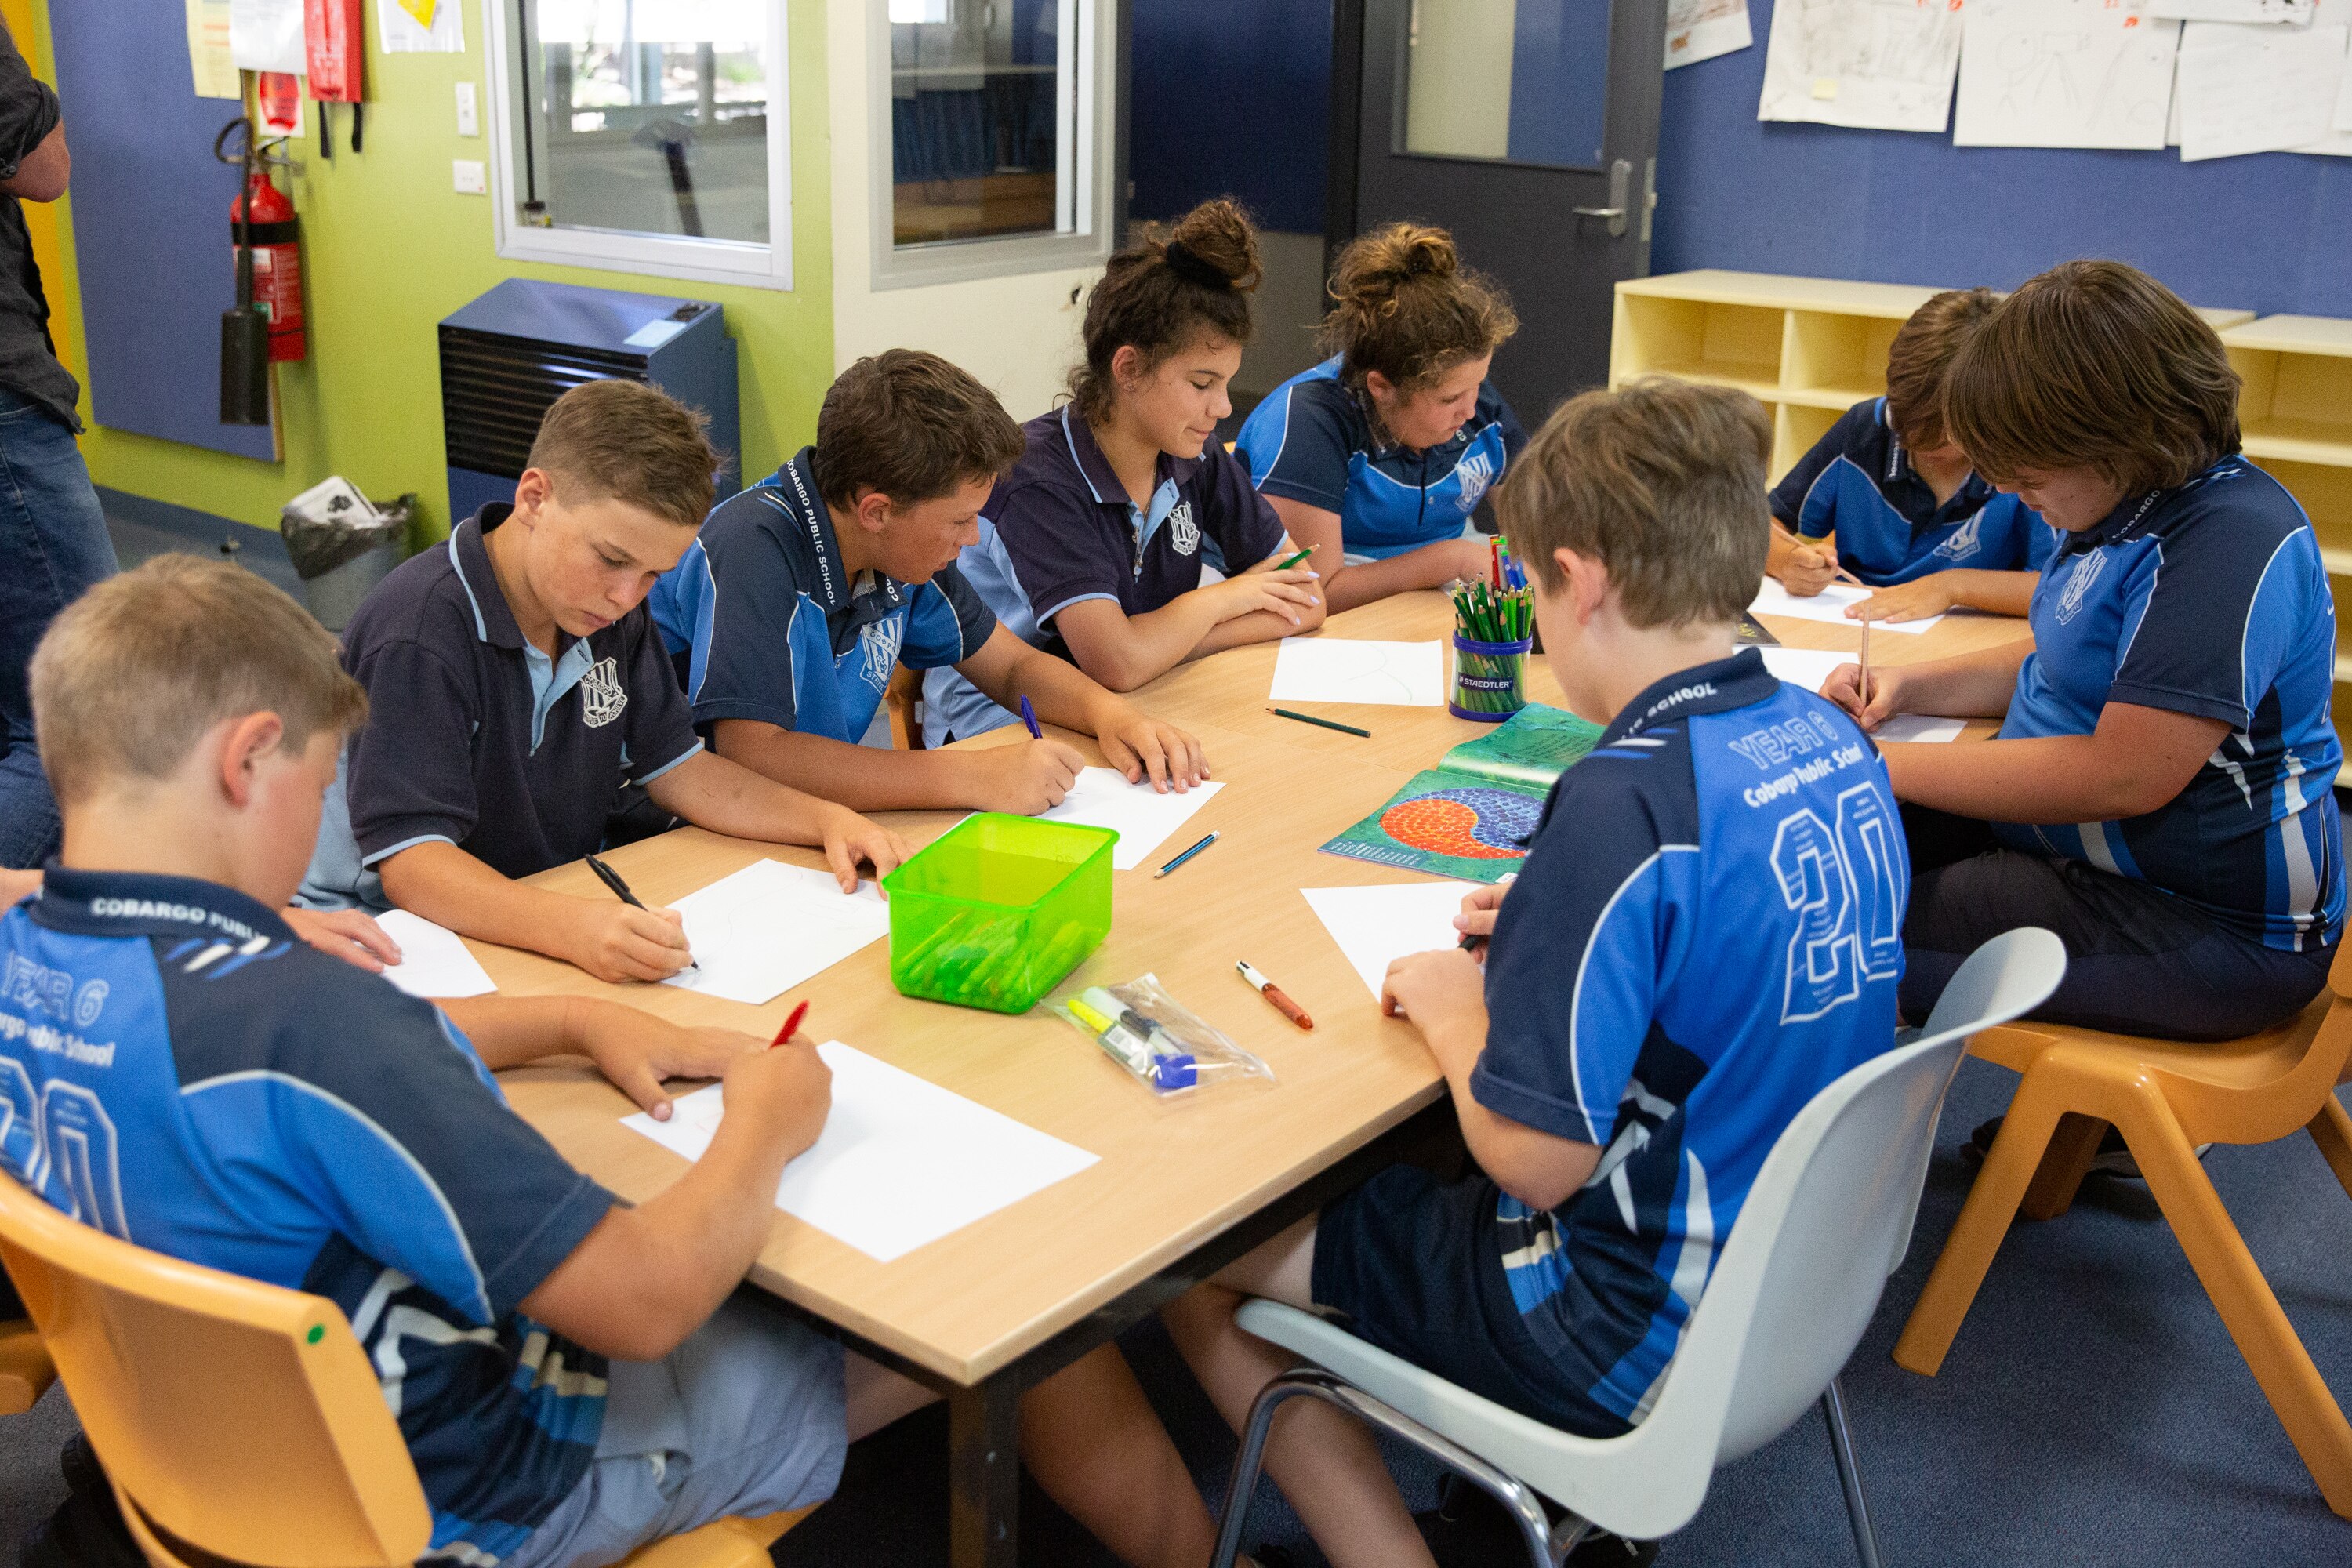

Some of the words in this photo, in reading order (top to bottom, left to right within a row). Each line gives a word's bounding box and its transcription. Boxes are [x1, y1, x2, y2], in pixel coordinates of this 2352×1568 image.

[2112, 490, 2160, 539] COBARGO
[805, 508, 824, 554] PUBLIC
[819, 556, 836, 606] SCHOOL
[584, 675, 613, 697] COBARGO
[1464, 678, 1510, 688] STAEDTLER
[1647, 681, 1717, 717] SCHOOL
[1727, 717, 1824, 770] YEAR
[1807, 710, 1838, 741] 6
[92, 898, 206, 924] COBARGO
[1769, 781, 1905, 1026] 20
[74, 978, 110, 1028] 6
[27, 1025, 64, 1055] ublic
